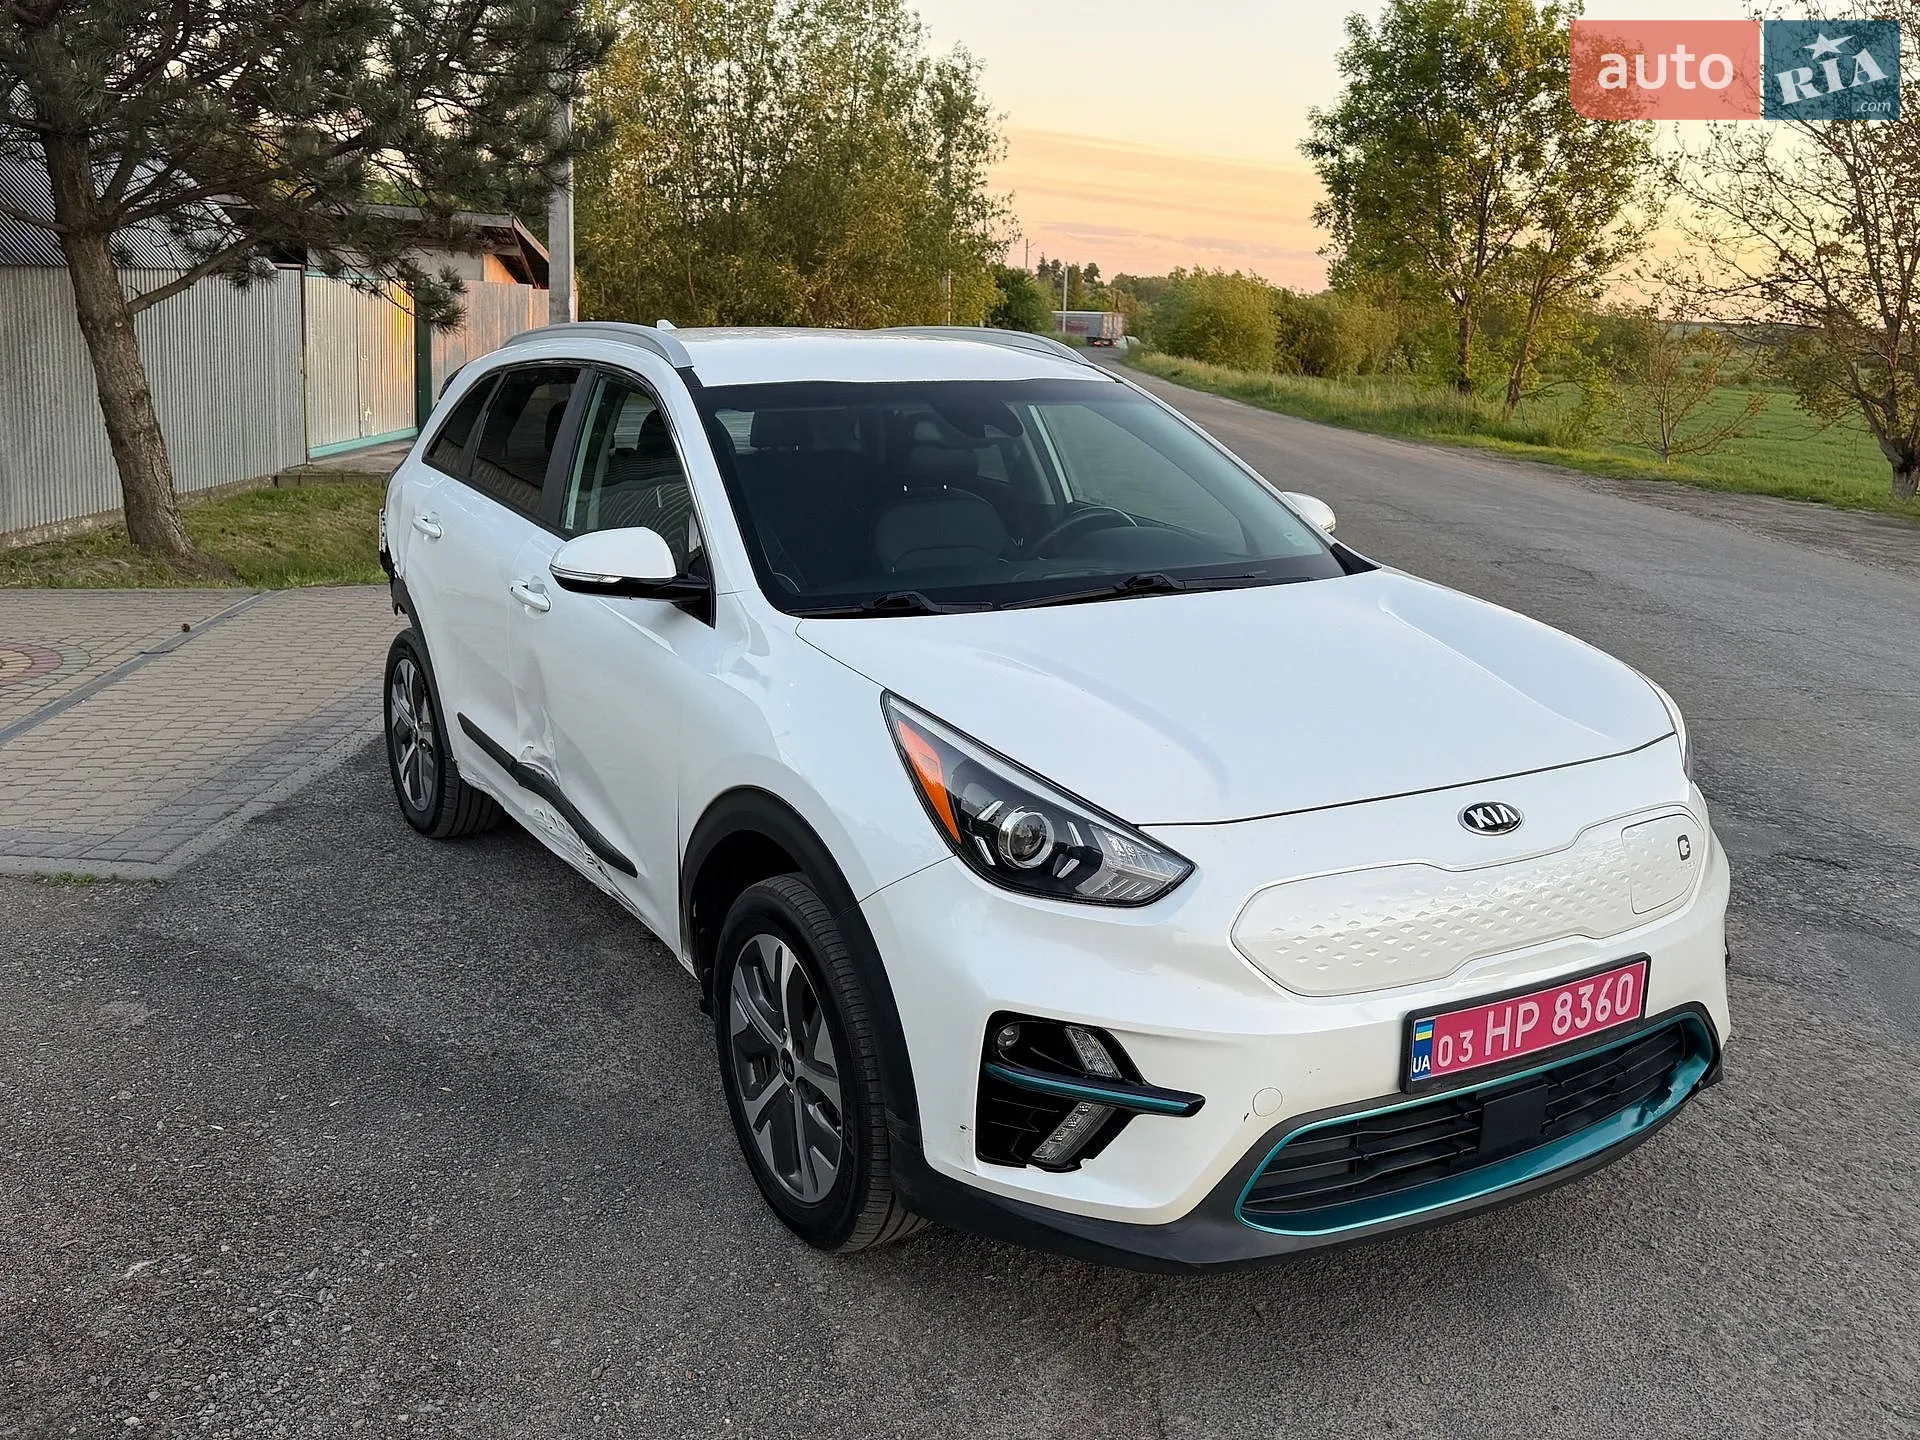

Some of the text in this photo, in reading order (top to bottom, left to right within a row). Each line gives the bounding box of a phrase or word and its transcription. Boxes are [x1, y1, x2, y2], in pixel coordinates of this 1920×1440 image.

[1467, 804, 1518, 828] KIA
[1437, 972, 1634, 1067] 03 HP 8360
[1413, 1055, 1431, 1073] UA
